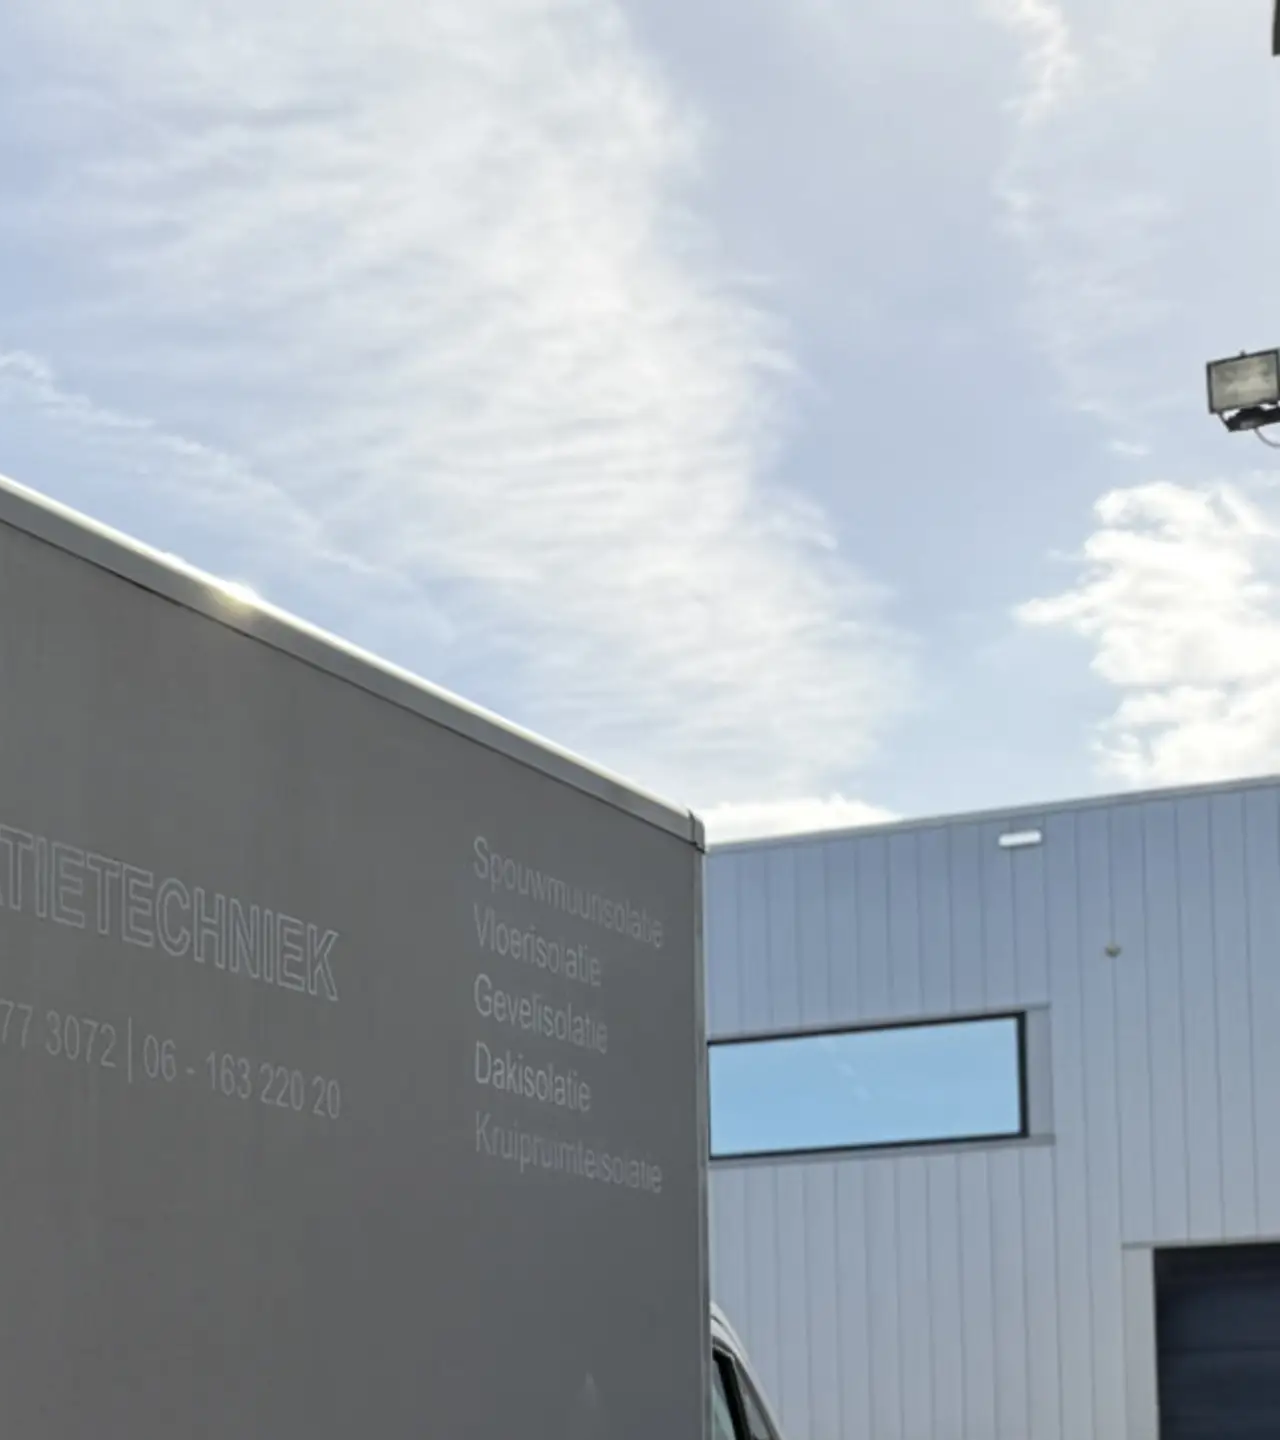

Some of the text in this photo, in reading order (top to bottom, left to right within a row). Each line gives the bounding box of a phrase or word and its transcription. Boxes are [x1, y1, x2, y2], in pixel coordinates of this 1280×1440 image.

[45, 1009, 117, 1067] 3072
[143, 1034, 177, 1082] 06
[206, 1050, 252, 1099] 163
[260, 1061, 305, 1111] 220
[312, 1075, 341, 1119] 20
[474, 1040, 592, 1113] Dakisolatie
